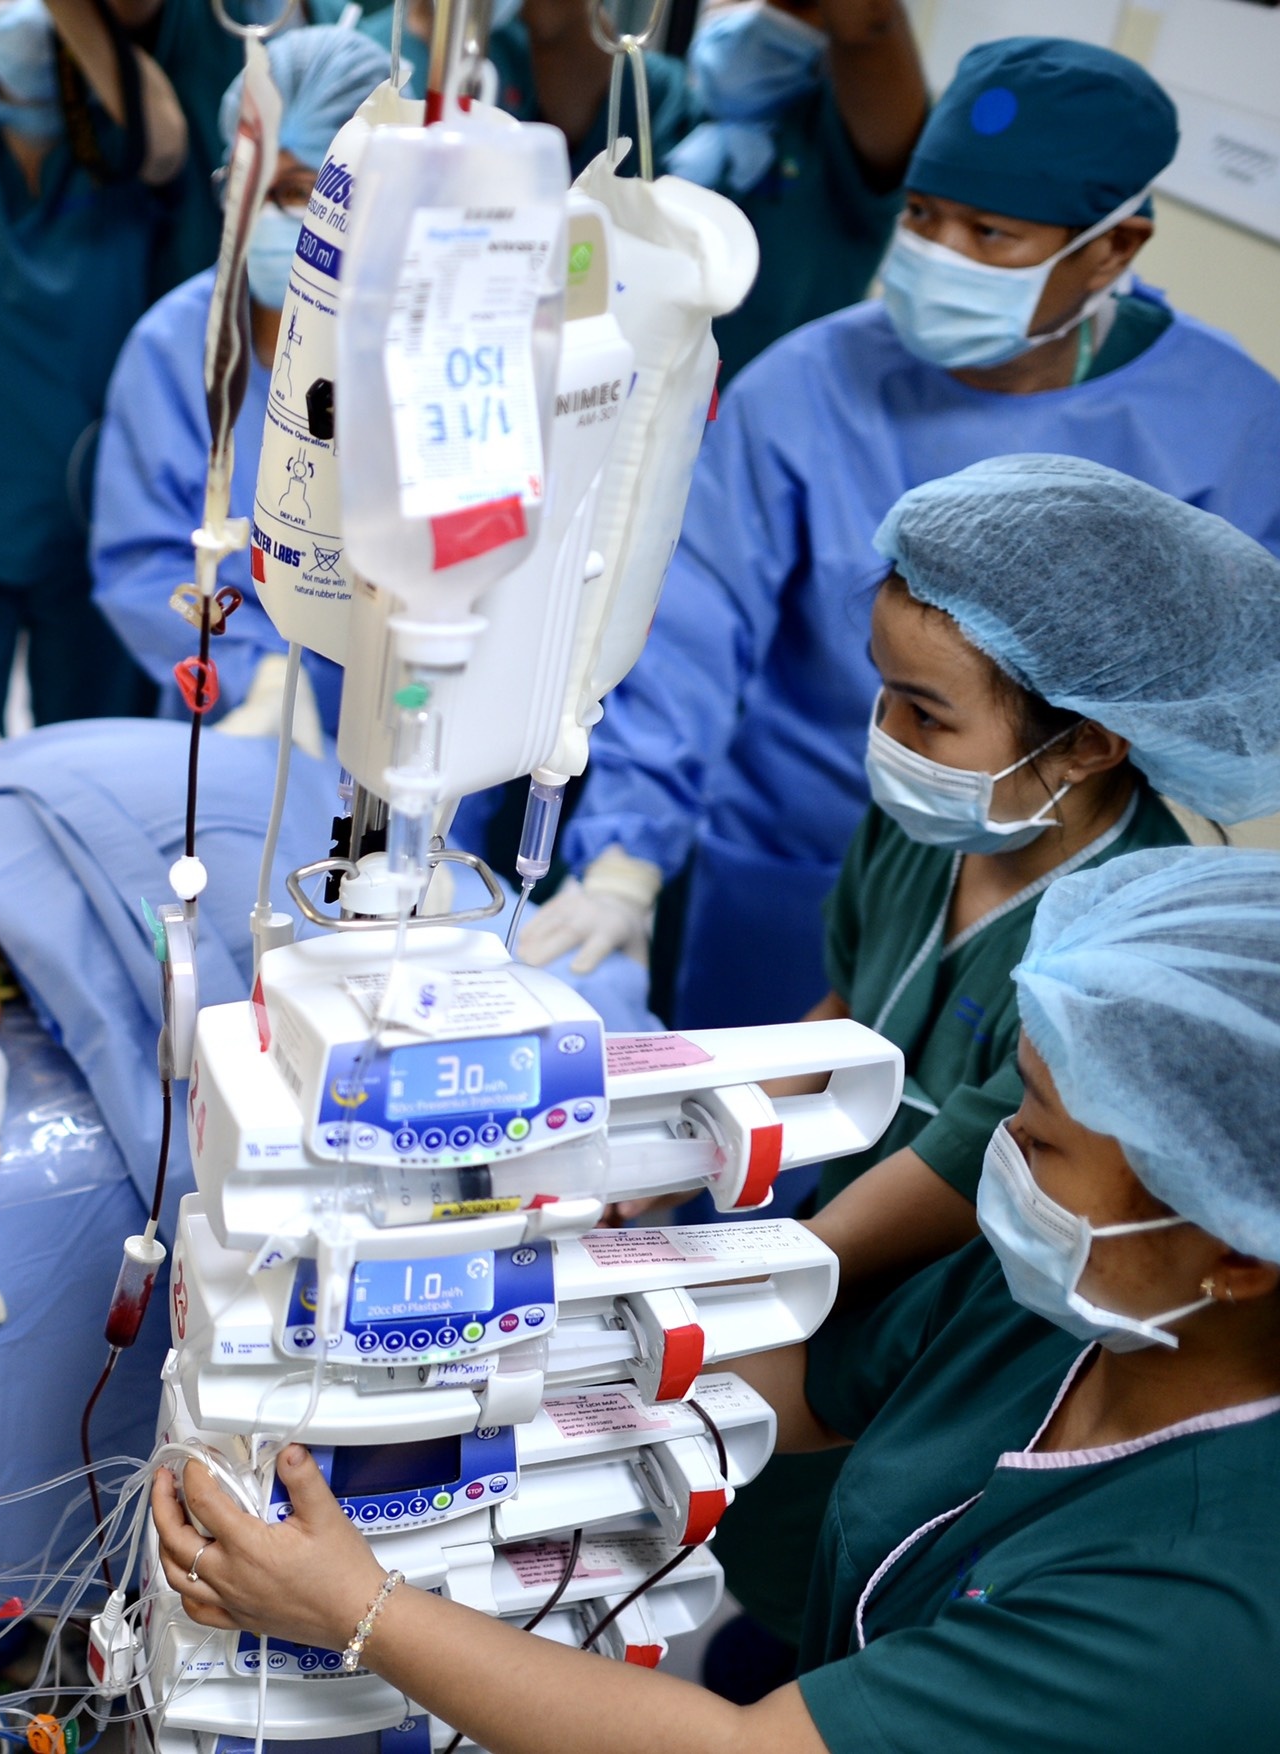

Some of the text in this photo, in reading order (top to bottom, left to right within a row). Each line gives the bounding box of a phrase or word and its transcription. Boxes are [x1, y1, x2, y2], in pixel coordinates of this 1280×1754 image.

[314, 154, 355, 210] Infus
[300, 231, 335, 268] 500 ml
[315, 299, 337, 316] Opera
[555, 379, 621, 416] NIMEC
[294, 429, 331, 450] Operation
[280, 510, 306, 526] DEFLATE
[302, 572, 347, 587] Not made with
[294, 584, 352, 600] natural rubber latex
[404, 1264, 442, 1302] 1.0
[392, 1303, 407, 1314] BD
[408, 1300, 453, 1312] Plastipak
[501, 1319, 518, 1328] STOP
[467, 1487, 483, 1495] STOP
